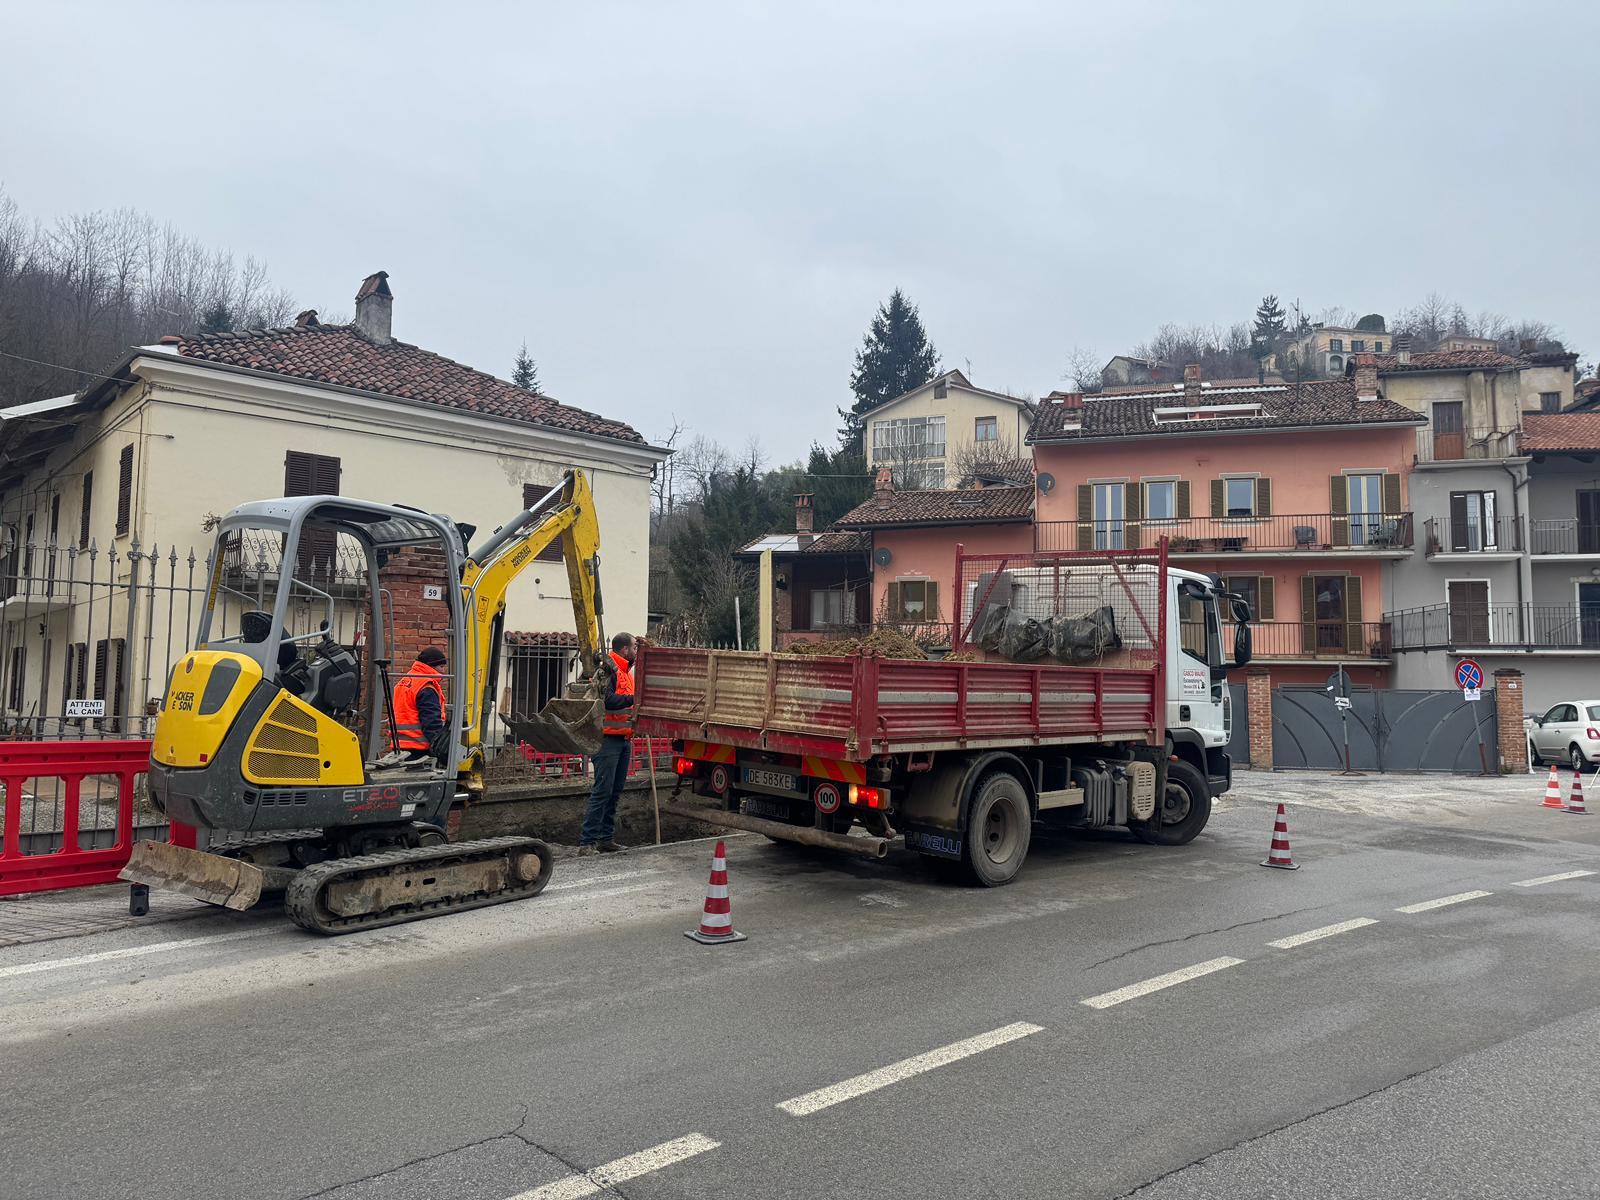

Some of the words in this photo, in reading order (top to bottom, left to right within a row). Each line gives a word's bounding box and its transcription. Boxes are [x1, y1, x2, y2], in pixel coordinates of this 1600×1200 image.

[171, 700, 193, 711] ESON
[715, 772, 724, 785] 80
[750, 770, 760, 784] DE
[763, 772, 791, 789] 583KE
[820, 791, 835, 804] 100
